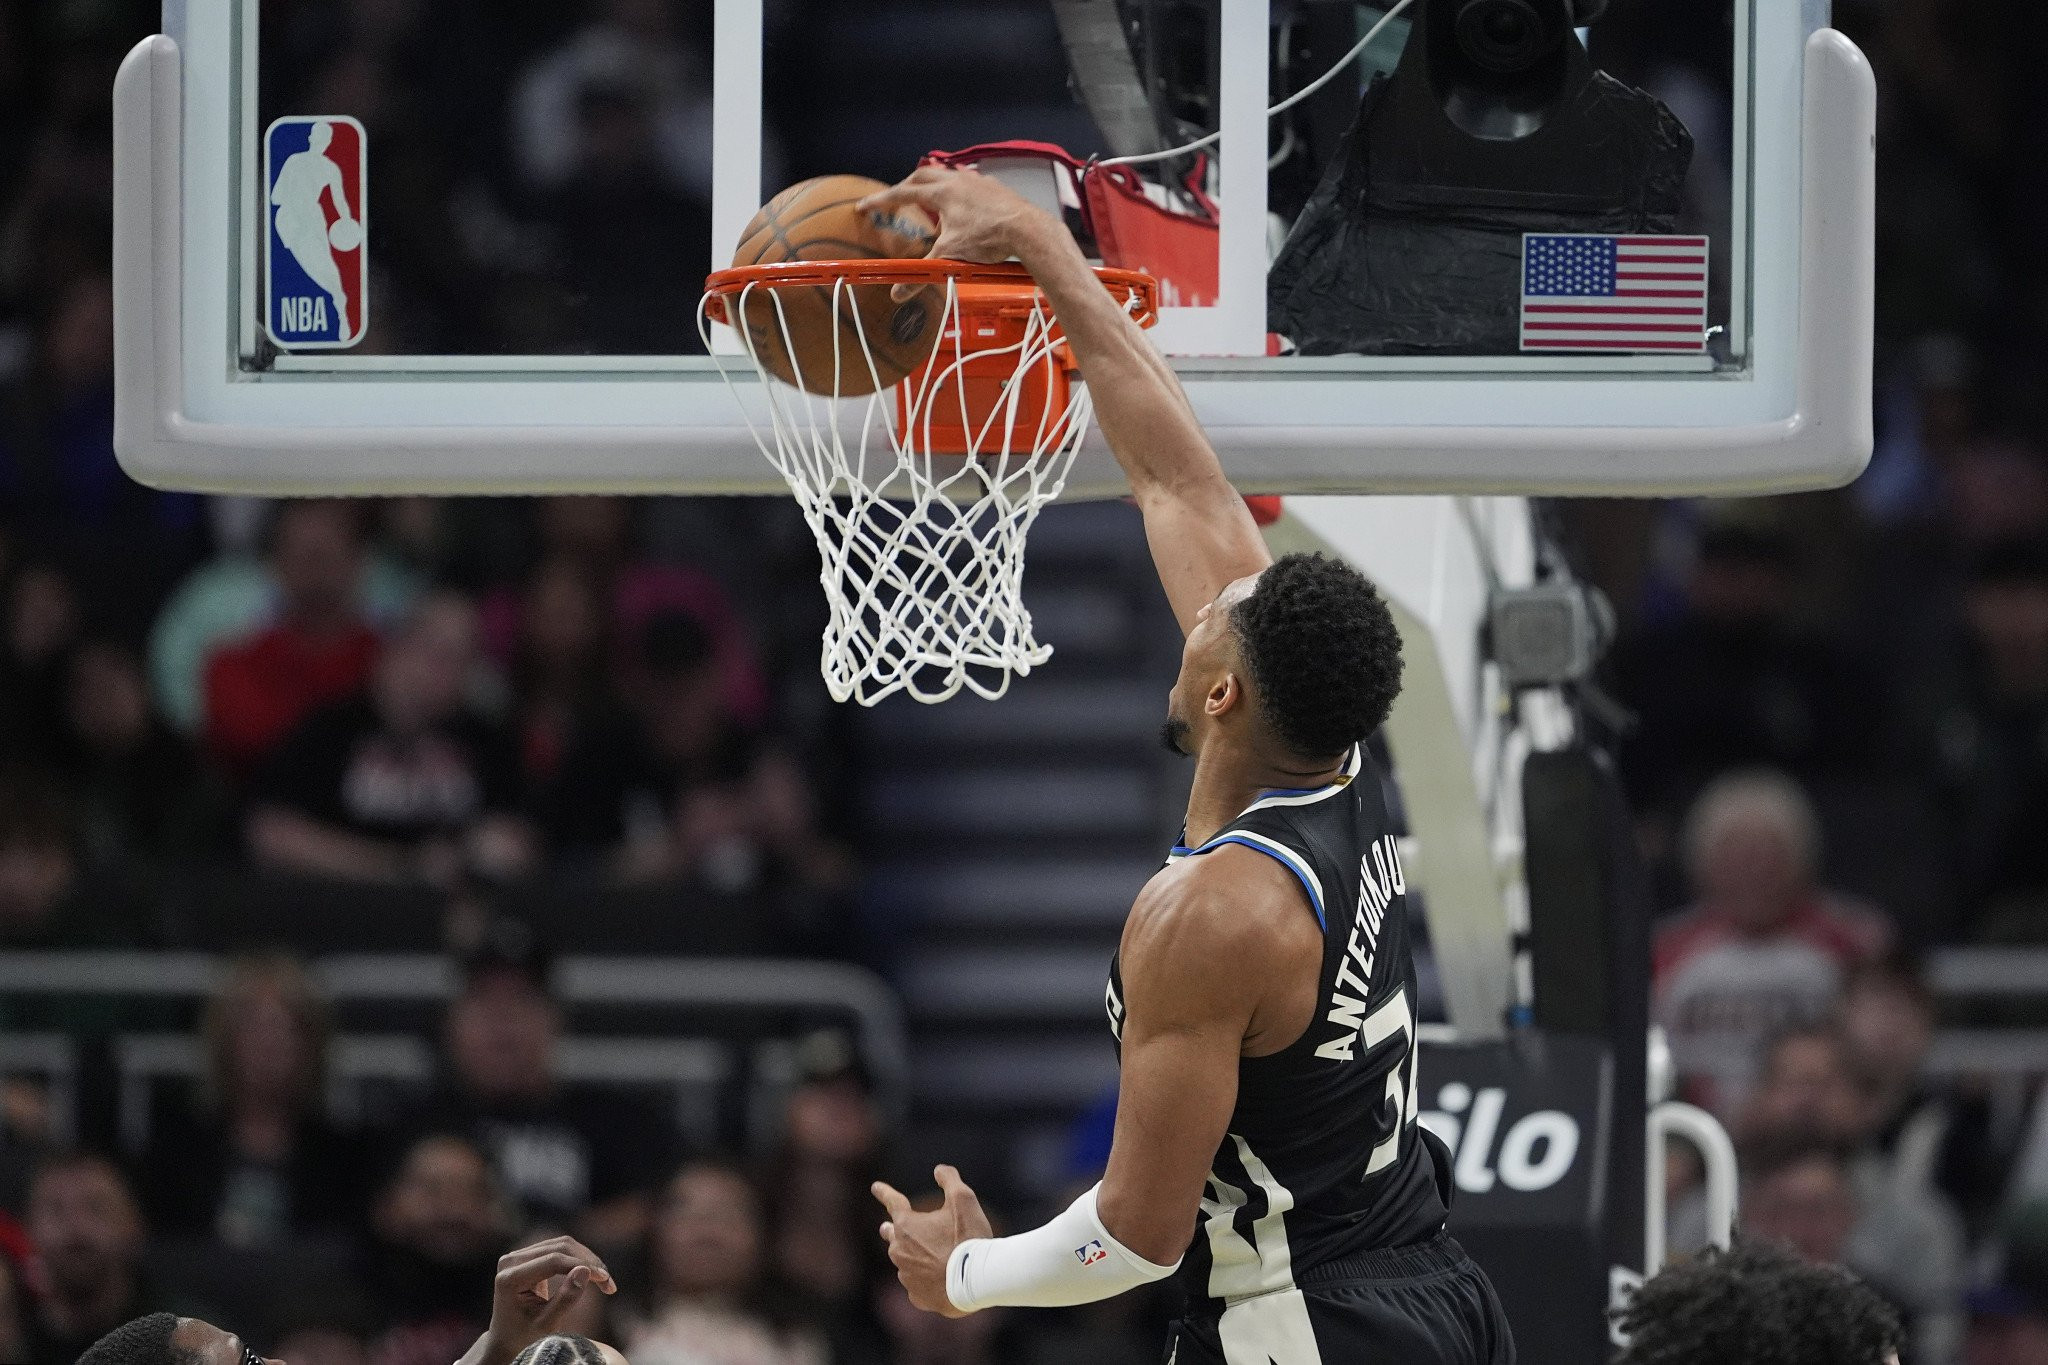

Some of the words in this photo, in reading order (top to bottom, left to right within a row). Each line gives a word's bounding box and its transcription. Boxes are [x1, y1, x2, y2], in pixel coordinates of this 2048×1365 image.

[281, 296, 328, 333] NBA
[1314, 834, 1406, 1063] ANTETOKOU
[1418, 1082, 1580, 1193] ilo
